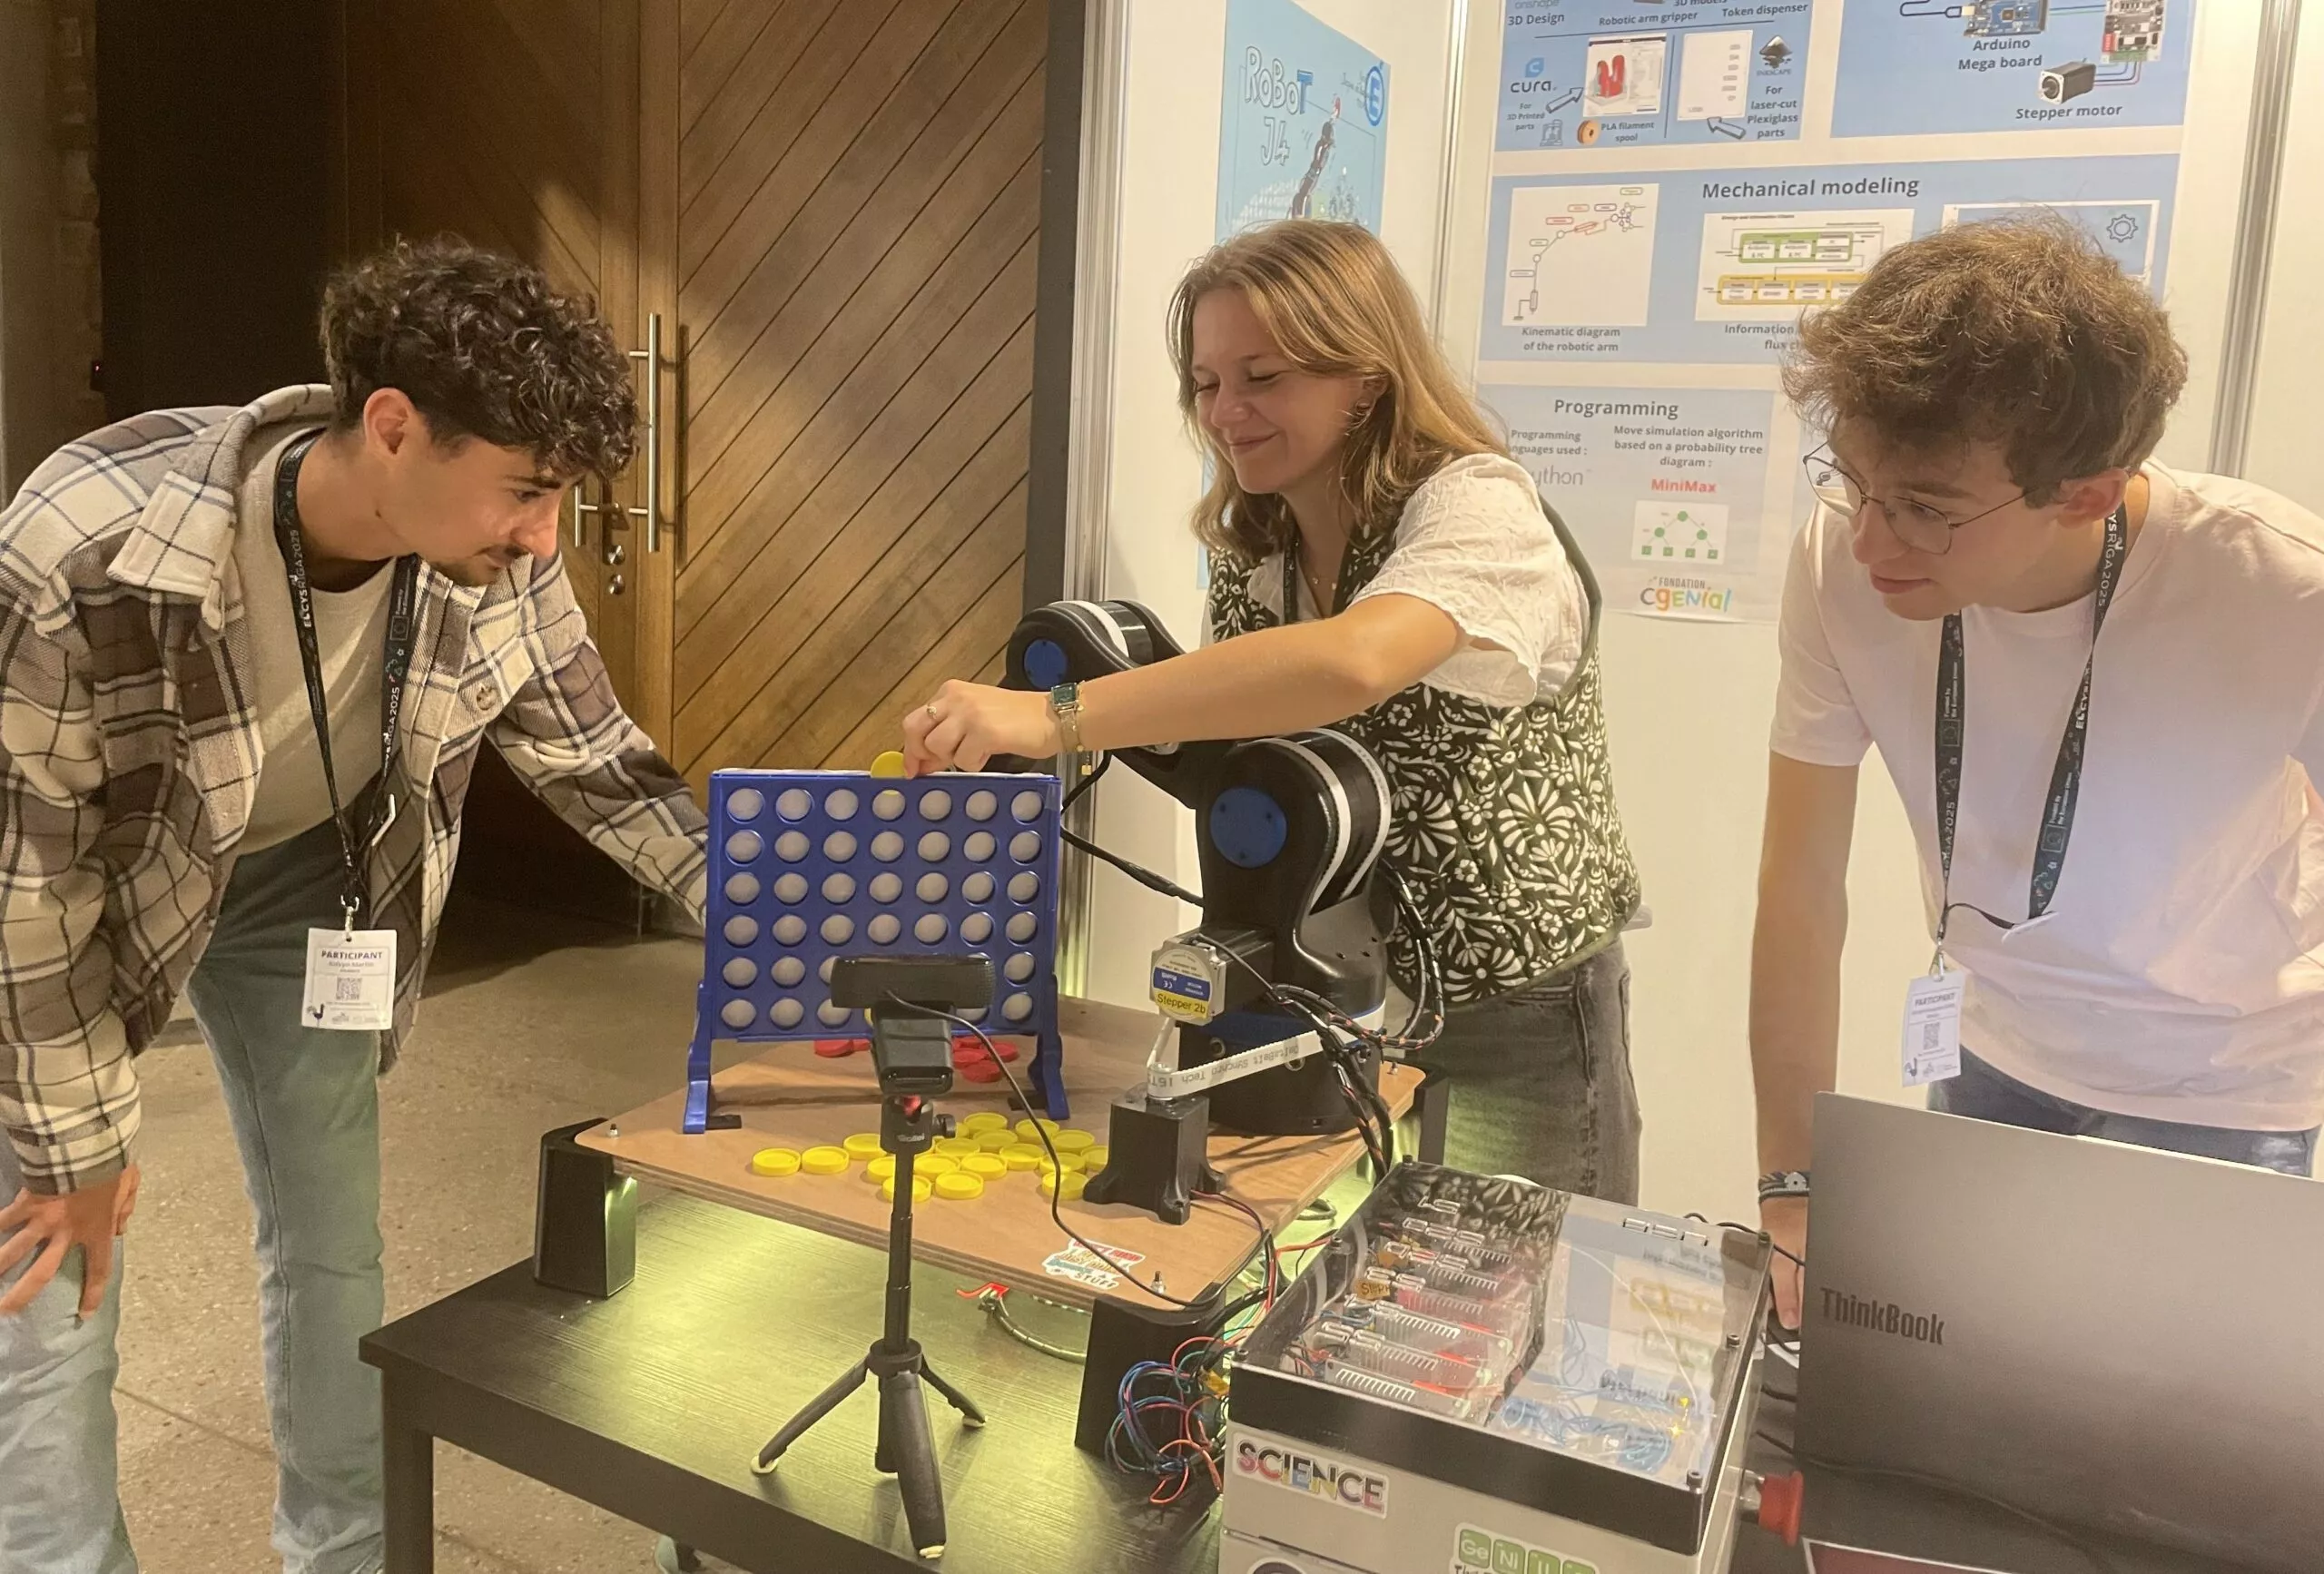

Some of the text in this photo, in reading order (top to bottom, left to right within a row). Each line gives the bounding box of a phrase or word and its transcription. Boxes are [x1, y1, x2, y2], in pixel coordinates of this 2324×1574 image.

[1722, 4, 1809, 17] Token dispenser
[1508, 13, 1565, 26] 3D Design
[1599, 12, 1698, 26] Robotic arm gripper
[1972, 37, 2031, 52] Arduino
[1958, 54, 2043, 71] Mega board
[1511, 80, 1552, 93] cura
[1766, 86, 1783, 95] For
[1750, 100, 1797, 110] laser-cut
[2015, 104, 2123, 121] Stepper motor
[1619, 122, 1655, 130] filament
[1748, 114, 1799, 125] Plexiglass
[1758, 128, 1786, 140] parts
[1702, 177, 1920, 199] Mechanical modeling
[1521, 326, 1620, 339] Kinematic diagram
[1724, 324, 1795, 334] Information
[1523, 340, 1619, 351] of the robotic arm
[1554, 399, 1679, 420] Programming
[1511, 430, 1581, 442] Programming
[1613, 425, 1763, 441] Move simulation algorithm
[1509, 446, 1555, 456] nguages
[1557, 446, 1581, 455] used
[1614, 440, 1763, 456] based on a probability tree
[1659, 457, 1706, 468] diagram
[1531, 464, 1584, 487] ython
[1650, 478, 1717, 493] MiniMax
[2097, 511, 2118, 608] YSRIGA2025
[1659, 576, 1706, 589] FONDATION
[321, 949, 383, 959] PARTICIPANT
[1157, 993, 1206, 1015] Stepper 2b
[1820, 1286, 1945, 1345] ThinkBook
[1237, 1439, 1386, 1512] SCIENCE
